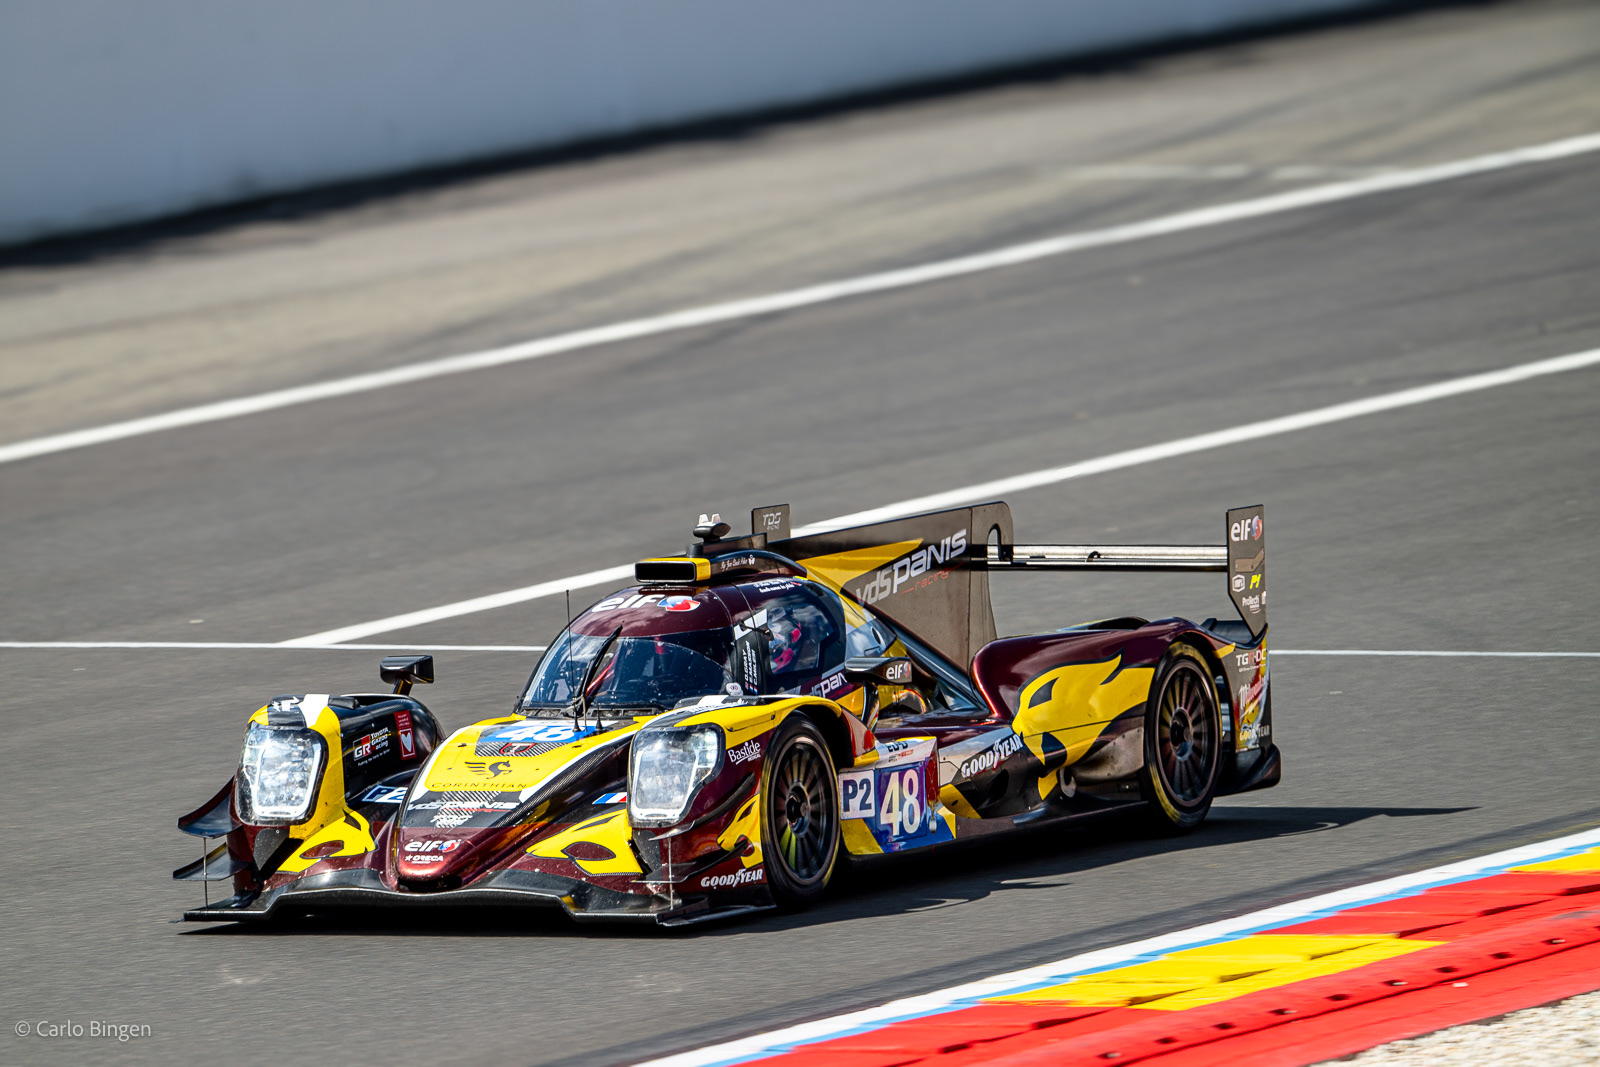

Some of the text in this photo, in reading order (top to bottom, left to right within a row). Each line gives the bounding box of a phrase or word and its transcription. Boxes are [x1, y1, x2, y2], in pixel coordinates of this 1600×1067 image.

[1230, 519, 1252, 542] elf
[591, 594, 666, 613] elf
[885, 663, 903, 680] elf
[496, 725, 586, 741] 48
[354, 743, 371, 758] GR
[727, 740, 761, 763] Bastide
[960, 734, 1024, 778] GOODYEAR
[842, 778, 872, 813] P2
[880, 769, 921, 836] 48
[404, 840, 443, 852] elf
[700, 868, 764, 888] GOODYEAR
